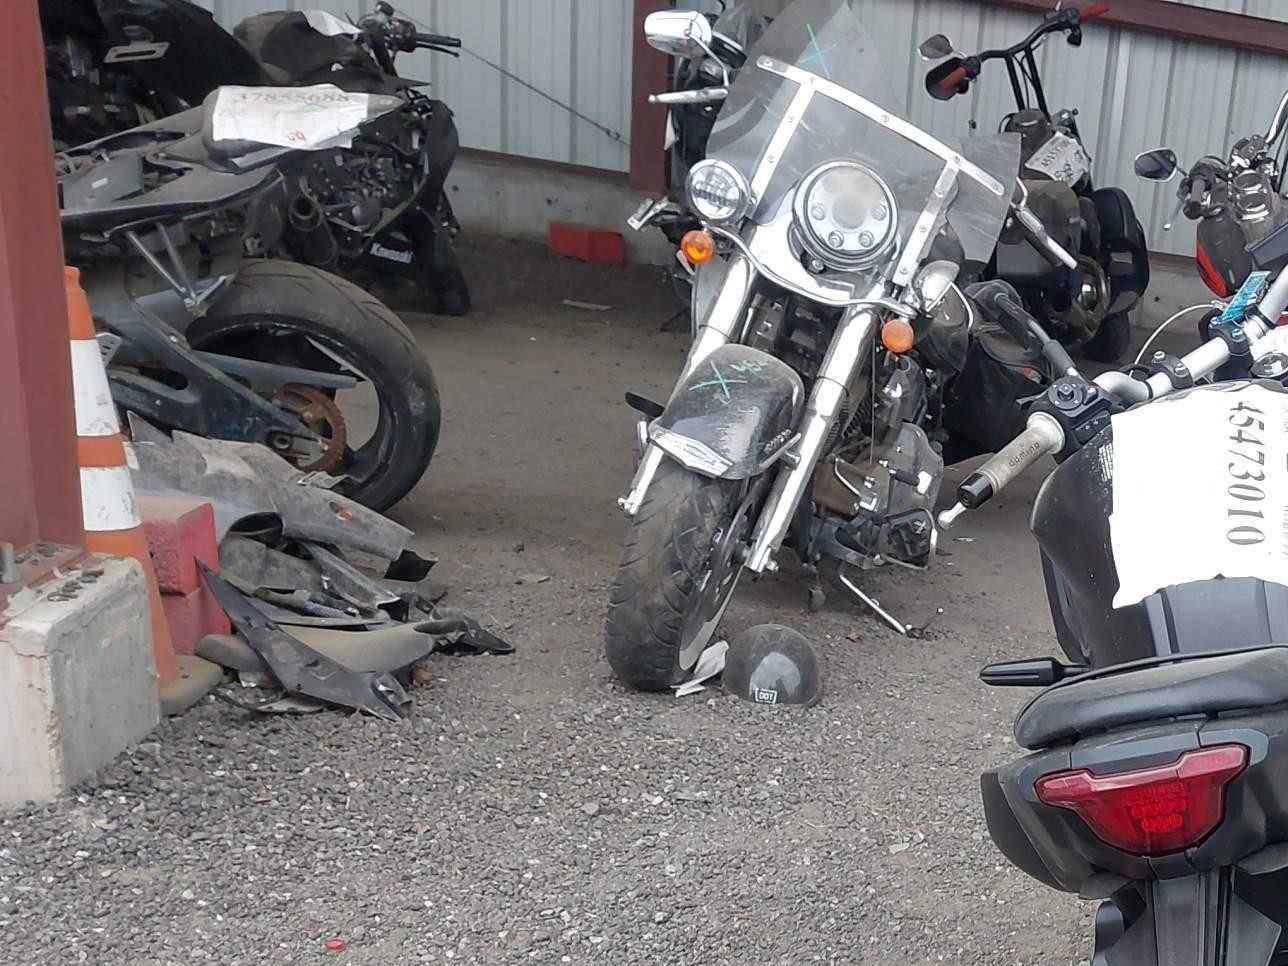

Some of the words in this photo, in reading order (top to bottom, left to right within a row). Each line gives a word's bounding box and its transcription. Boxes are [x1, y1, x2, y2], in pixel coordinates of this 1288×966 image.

[370, 242, 414, 264] Kawasaki
[1007, 441, 1041, 467] domino
[1226, 400, 1267, 546] 45473010
[758, 690, 775, 701] DOT
